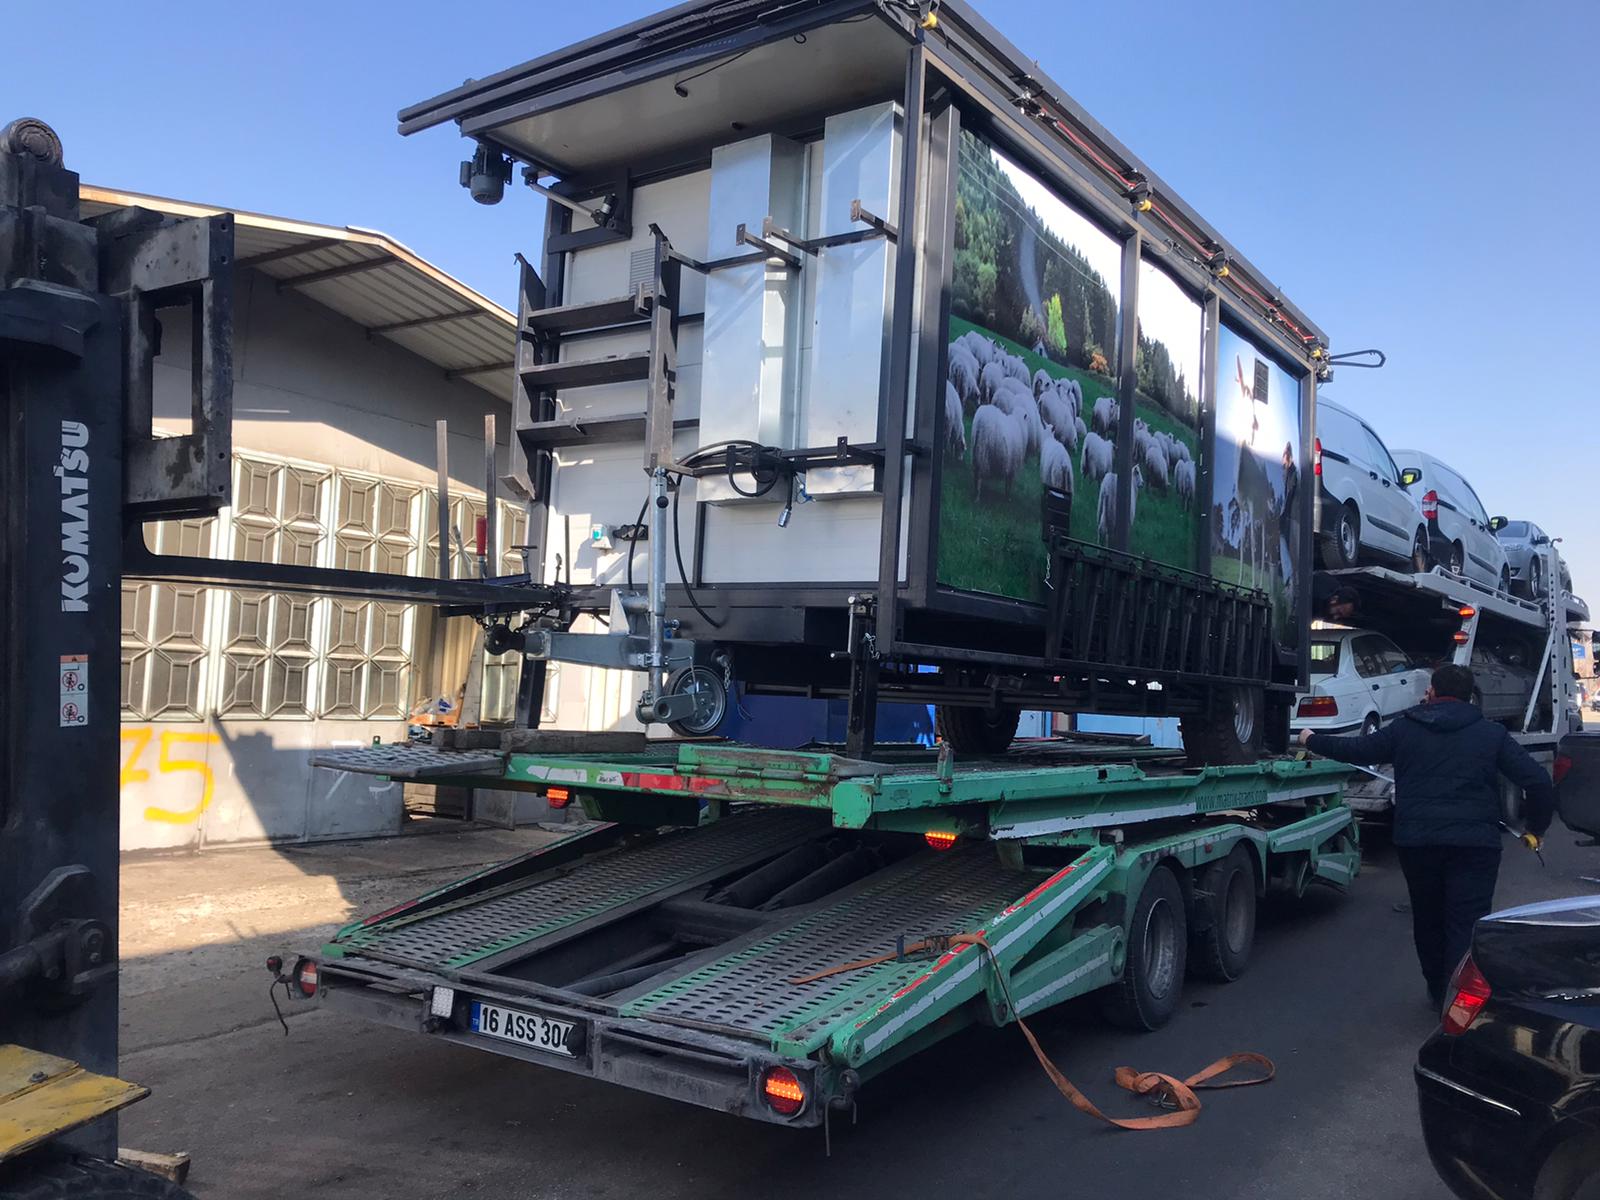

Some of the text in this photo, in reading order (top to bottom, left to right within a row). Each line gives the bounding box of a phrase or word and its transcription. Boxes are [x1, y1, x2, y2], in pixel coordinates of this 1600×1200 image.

[53, 420, 90, 612] KOMATSU
[482, 1007, 499, 1033] 16
[504, 1013, 536, 1042] ASS
